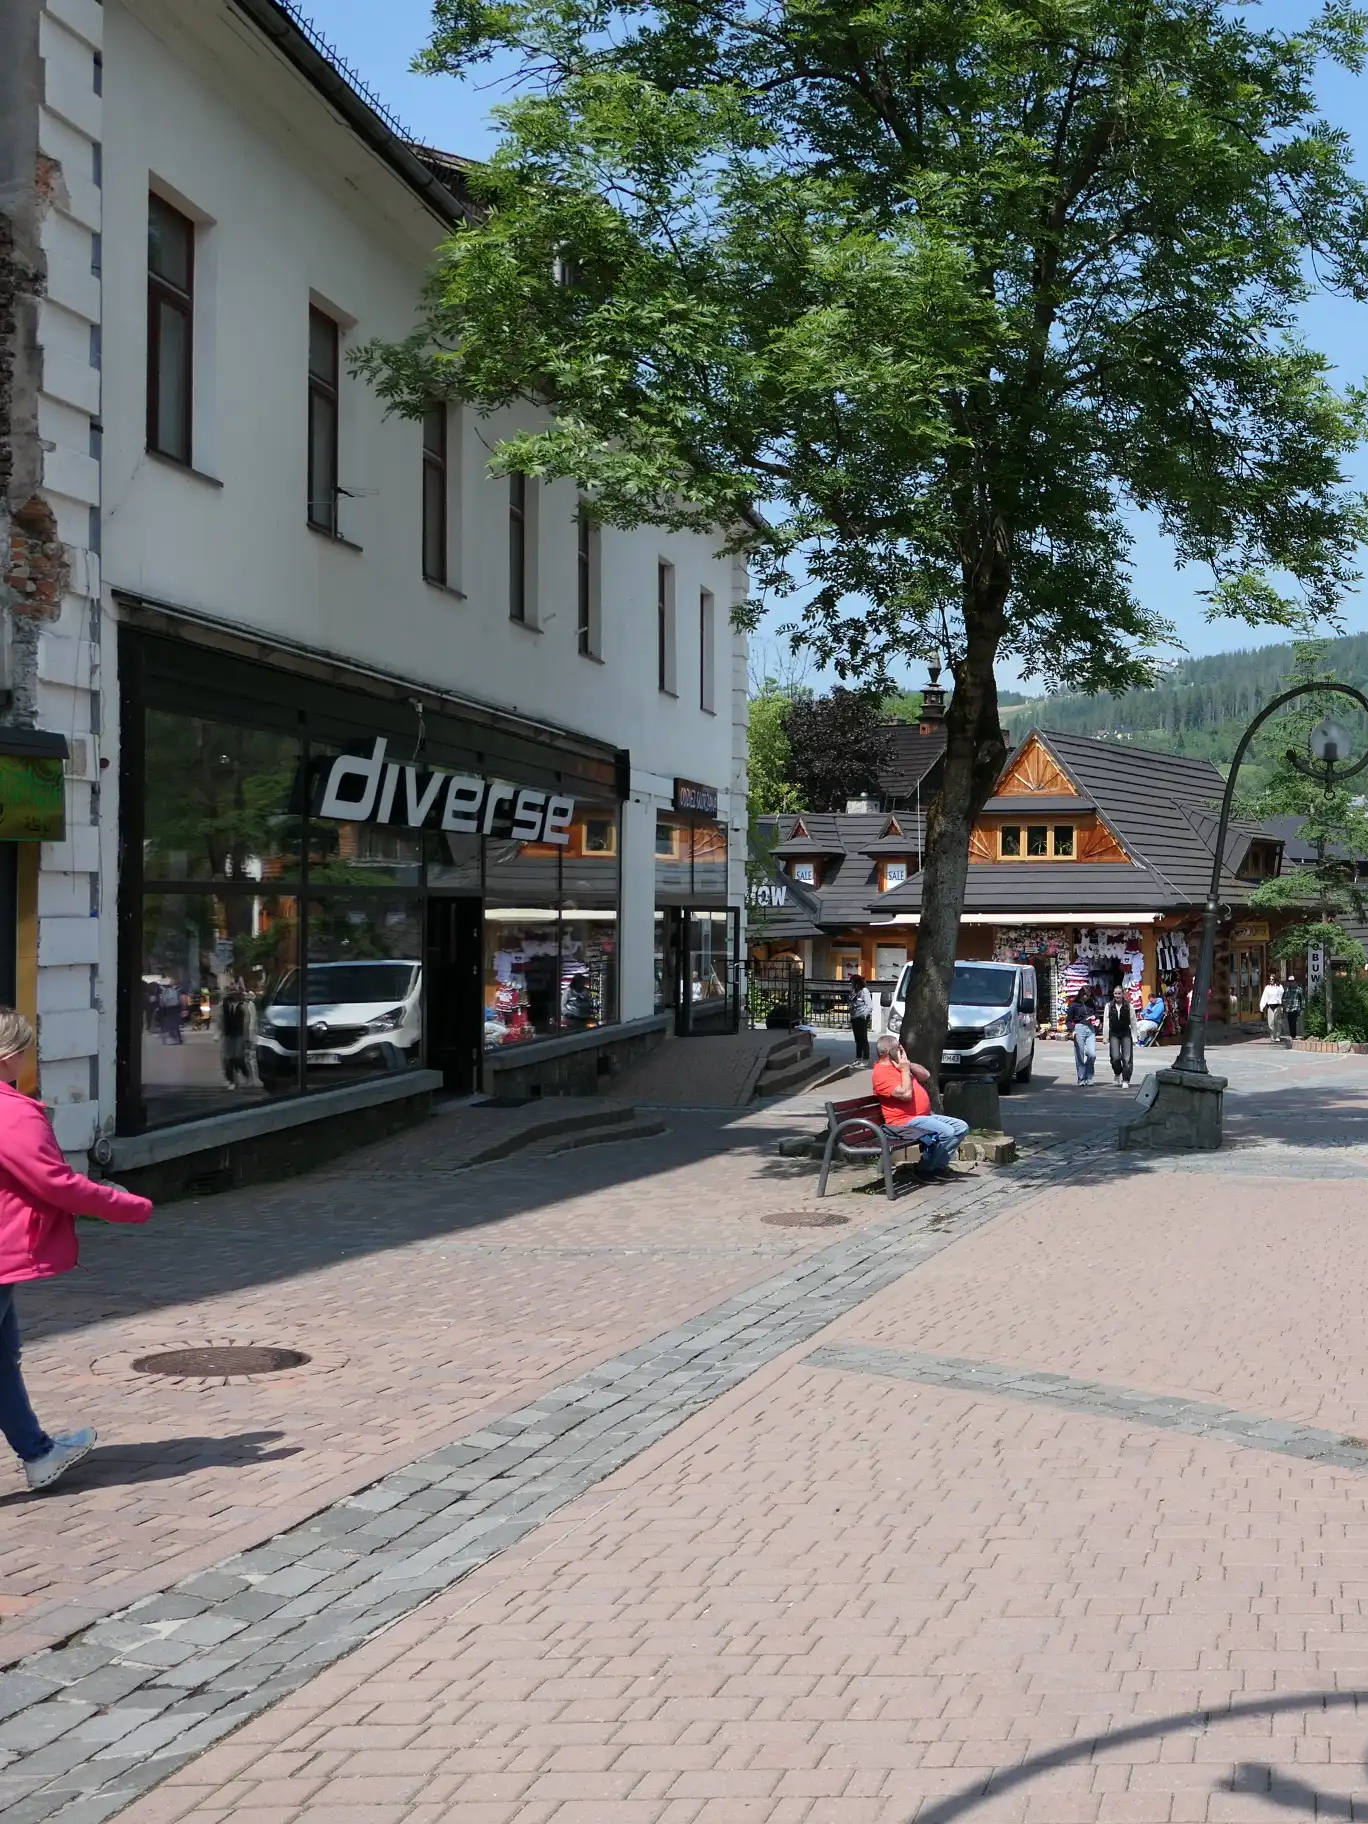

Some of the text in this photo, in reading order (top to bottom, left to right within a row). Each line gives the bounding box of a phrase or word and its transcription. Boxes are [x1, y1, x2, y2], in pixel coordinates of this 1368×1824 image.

[320, 736, 575, 844] diverse
[796, 870, 812, 881] SALE
[887, 870, 904, 881] SALE
